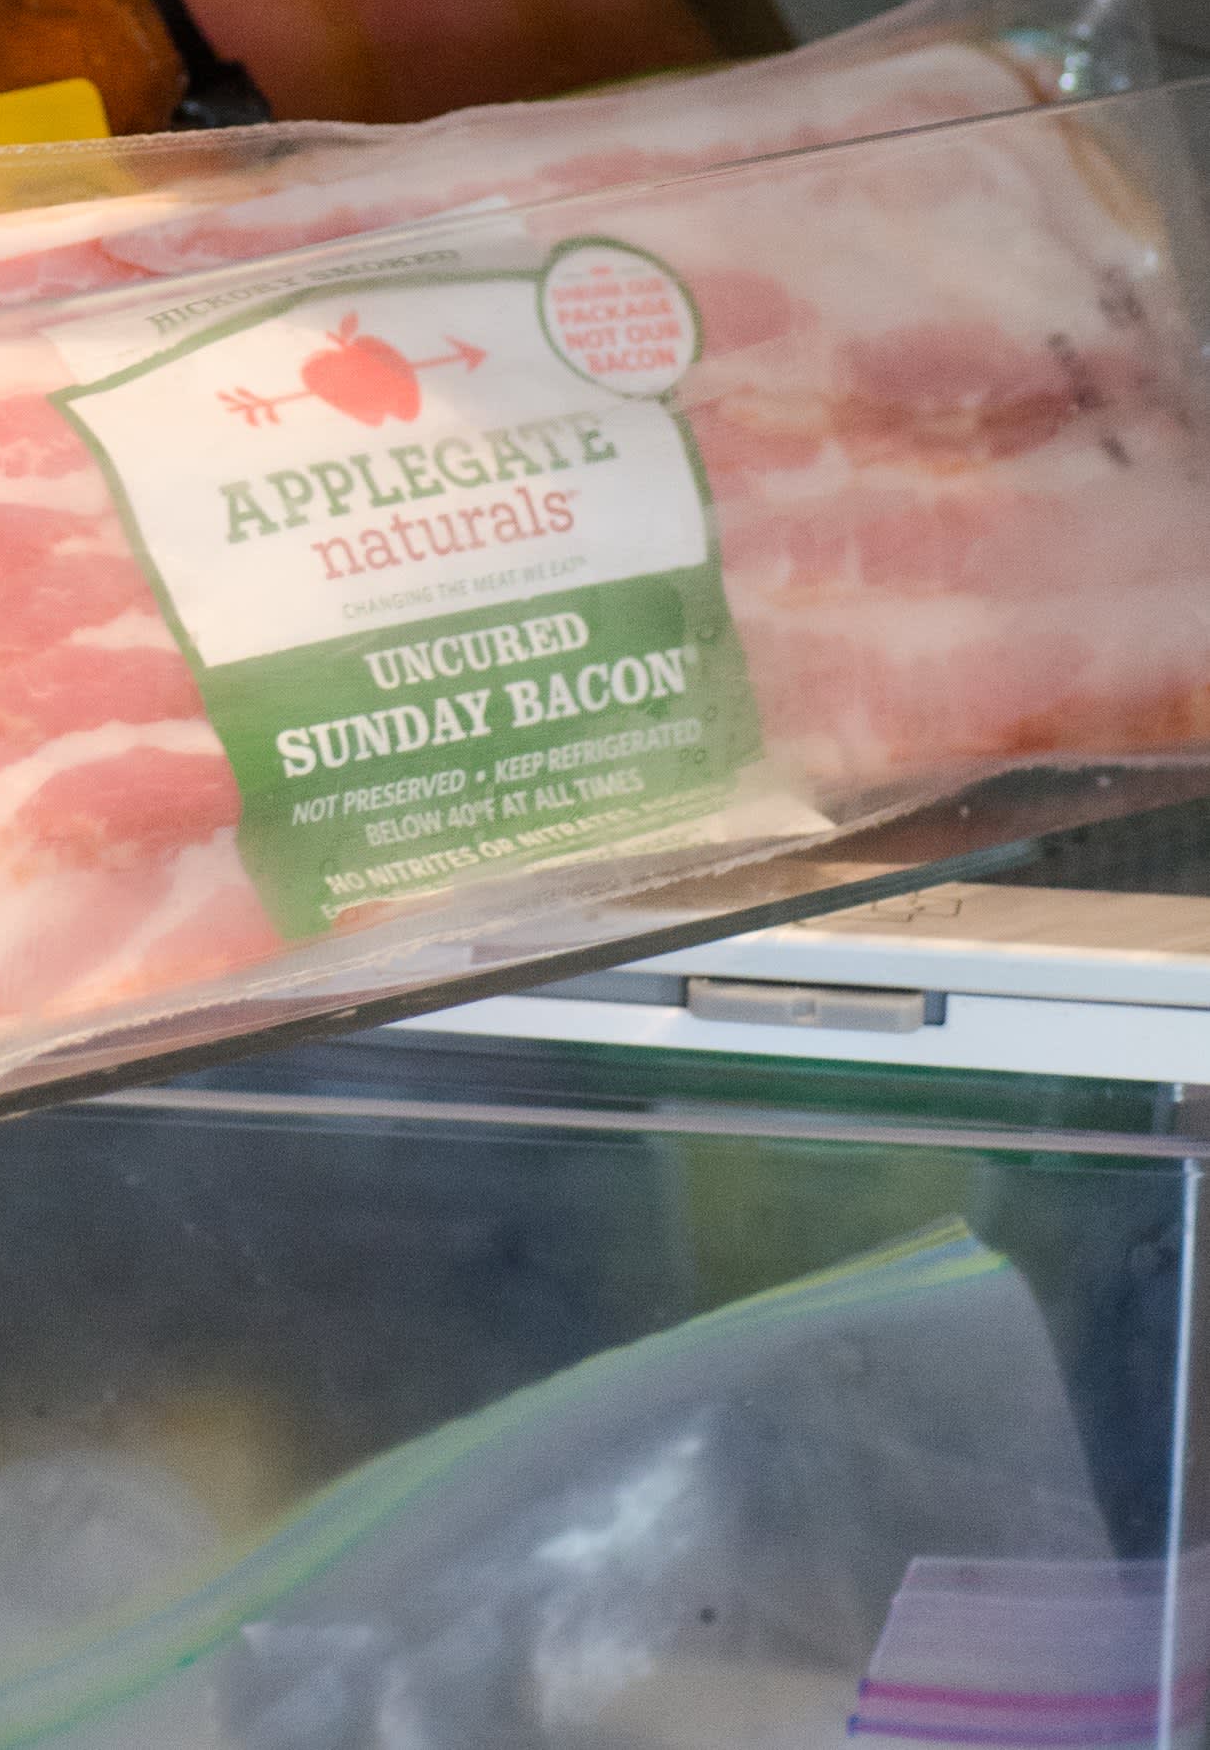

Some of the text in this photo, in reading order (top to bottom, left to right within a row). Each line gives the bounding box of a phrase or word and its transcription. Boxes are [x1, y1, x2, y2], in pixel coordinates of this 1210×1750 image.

[145, 274, 299, 336] HICKORY
[557, 297, 673, 326] PACKAGE
[564, 320, 682, 350] NOT OUR
[585, 346, 677, 374] BACON
[220, 410, 619, 544] APPLEGATE
[311, 486, 575, 581] naturals
[342, 586, 434, 620] CHANGING
[437, 580, 468, 602] THE
[472, 569, 515, 594] MEAT
[522, 564, 547, 584] WE
[363, 612, 590, 692] UNCURED
[276, 688, 492, 779] SUNDAY
[291, 718, 702, 827] NOT PRESERVED KEEP REFRIGERATED
[364, 811, 443, 848] BELOW
[501, 790, 530, 818] AT
[533, 780, 575, 811] ALL
[575, 766, 645, 803] TIMES
[324, 870, 367, 896] NO
[366, 843, 480, 890] NITRITES
[478, 834, 518, 858] OR
